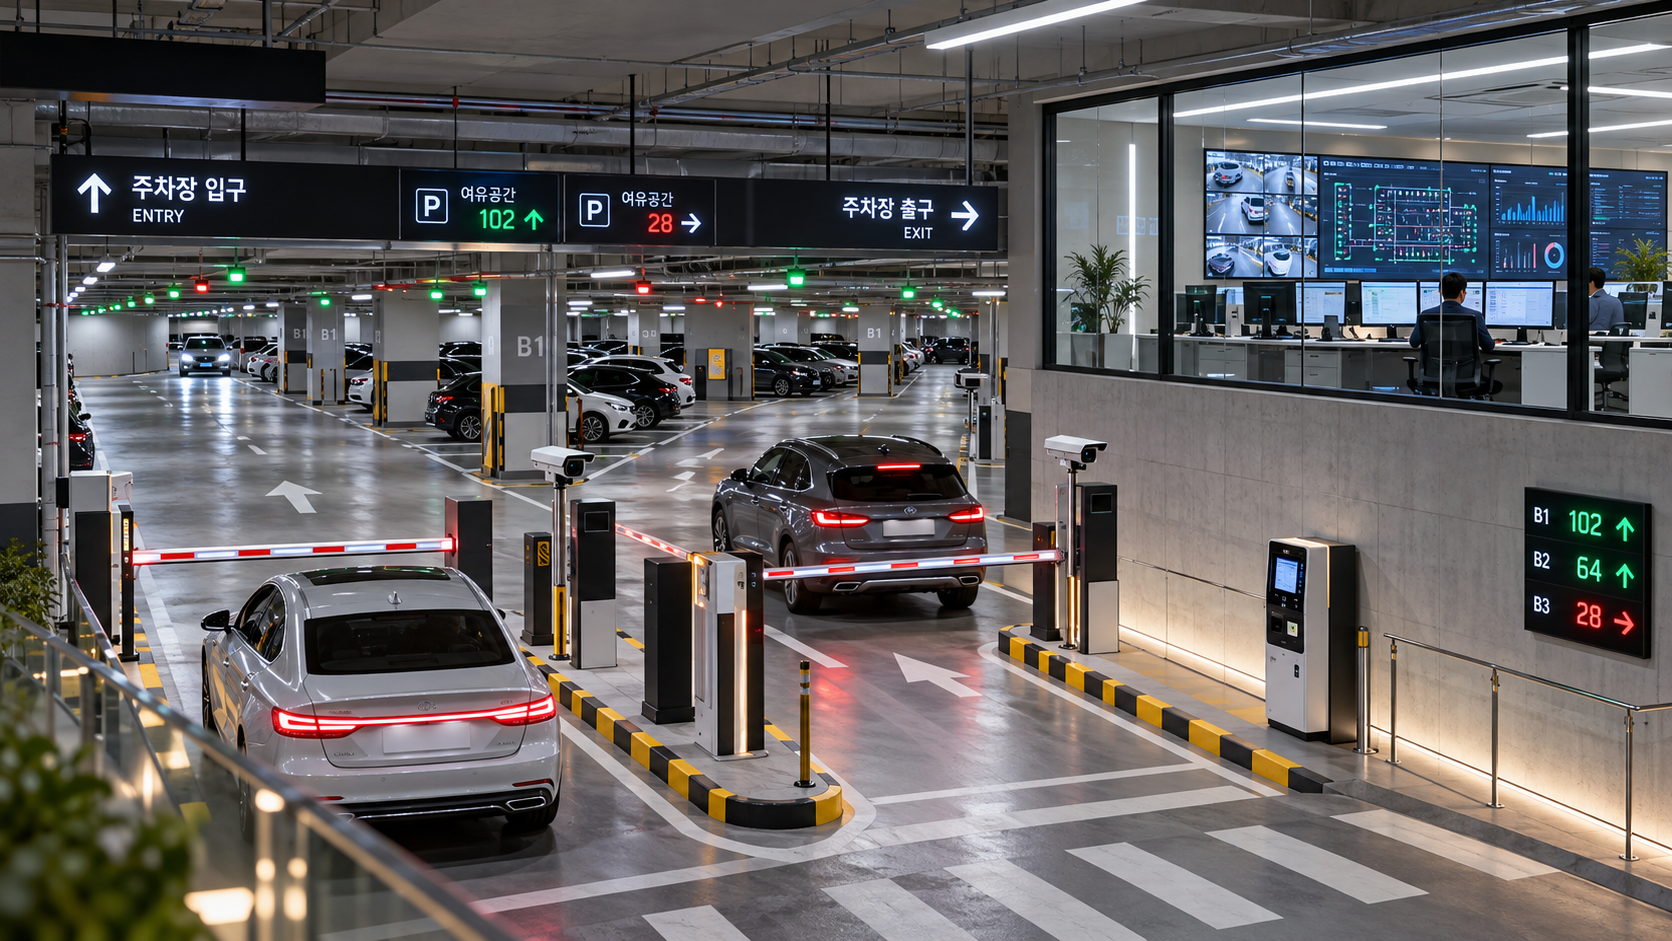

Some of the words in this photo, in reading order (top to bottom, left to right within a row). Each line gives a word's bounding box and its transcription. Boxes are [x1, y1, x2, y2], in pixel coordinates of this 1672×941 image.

[131, 174, 198, 202] 주차장
[204, 177, 247, 203] 입구
[460, 185, 517, 204] 여유공간
[621, 190, 674, 208] 여유공간
[132, 208, 186, 224] ENTRY
[423, 194, 441, 218] P
[587, 199, 602, 222] P
[842, 196, 895, 220] 주차장
[899, 197, 935, 221] 출구
[479, 208, 516, 231] 102
[647, 212, 674, 234] 28
[903, 226, 934, 240] EXIT
[321, 328, 336, 341] B1
[867, 327, 882, 339] B1
[517, 335, 544, 357] B1
[1533, 506, 1550, 525] B1
[1568, 509, 1602, 537] 102
[1533, 550, 1551, 570] B2
[1576, 555, 1602, 583] 64
[1533, 595, 1551, 615] B3
[1576, 601, 1602, 629] 28
